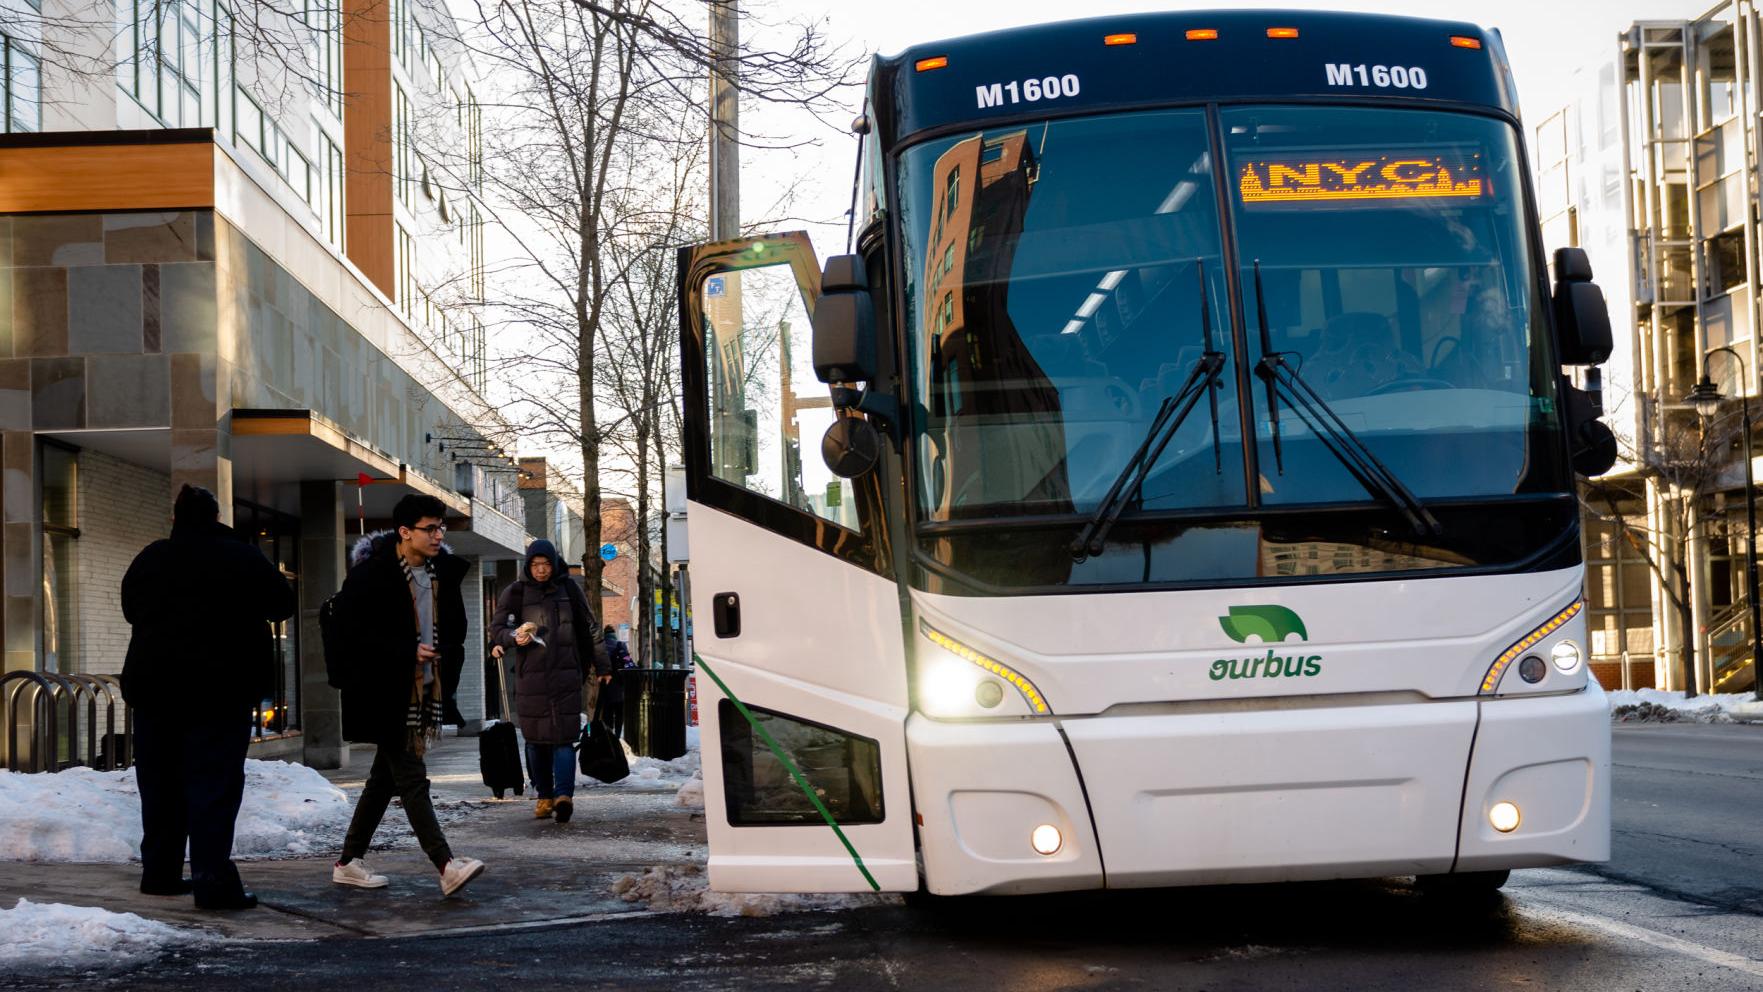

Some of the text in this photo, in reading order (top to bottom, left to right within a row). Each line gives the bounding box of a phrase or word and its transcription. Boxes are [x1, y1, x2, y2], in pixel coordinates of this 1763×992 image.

[975, 73, 1081, 109] M1600
[1324, 63, 1428, 90] M1600
[1268, 160, 1436, 186] NYC
[1208, 649, 1322, 681] ourbus
